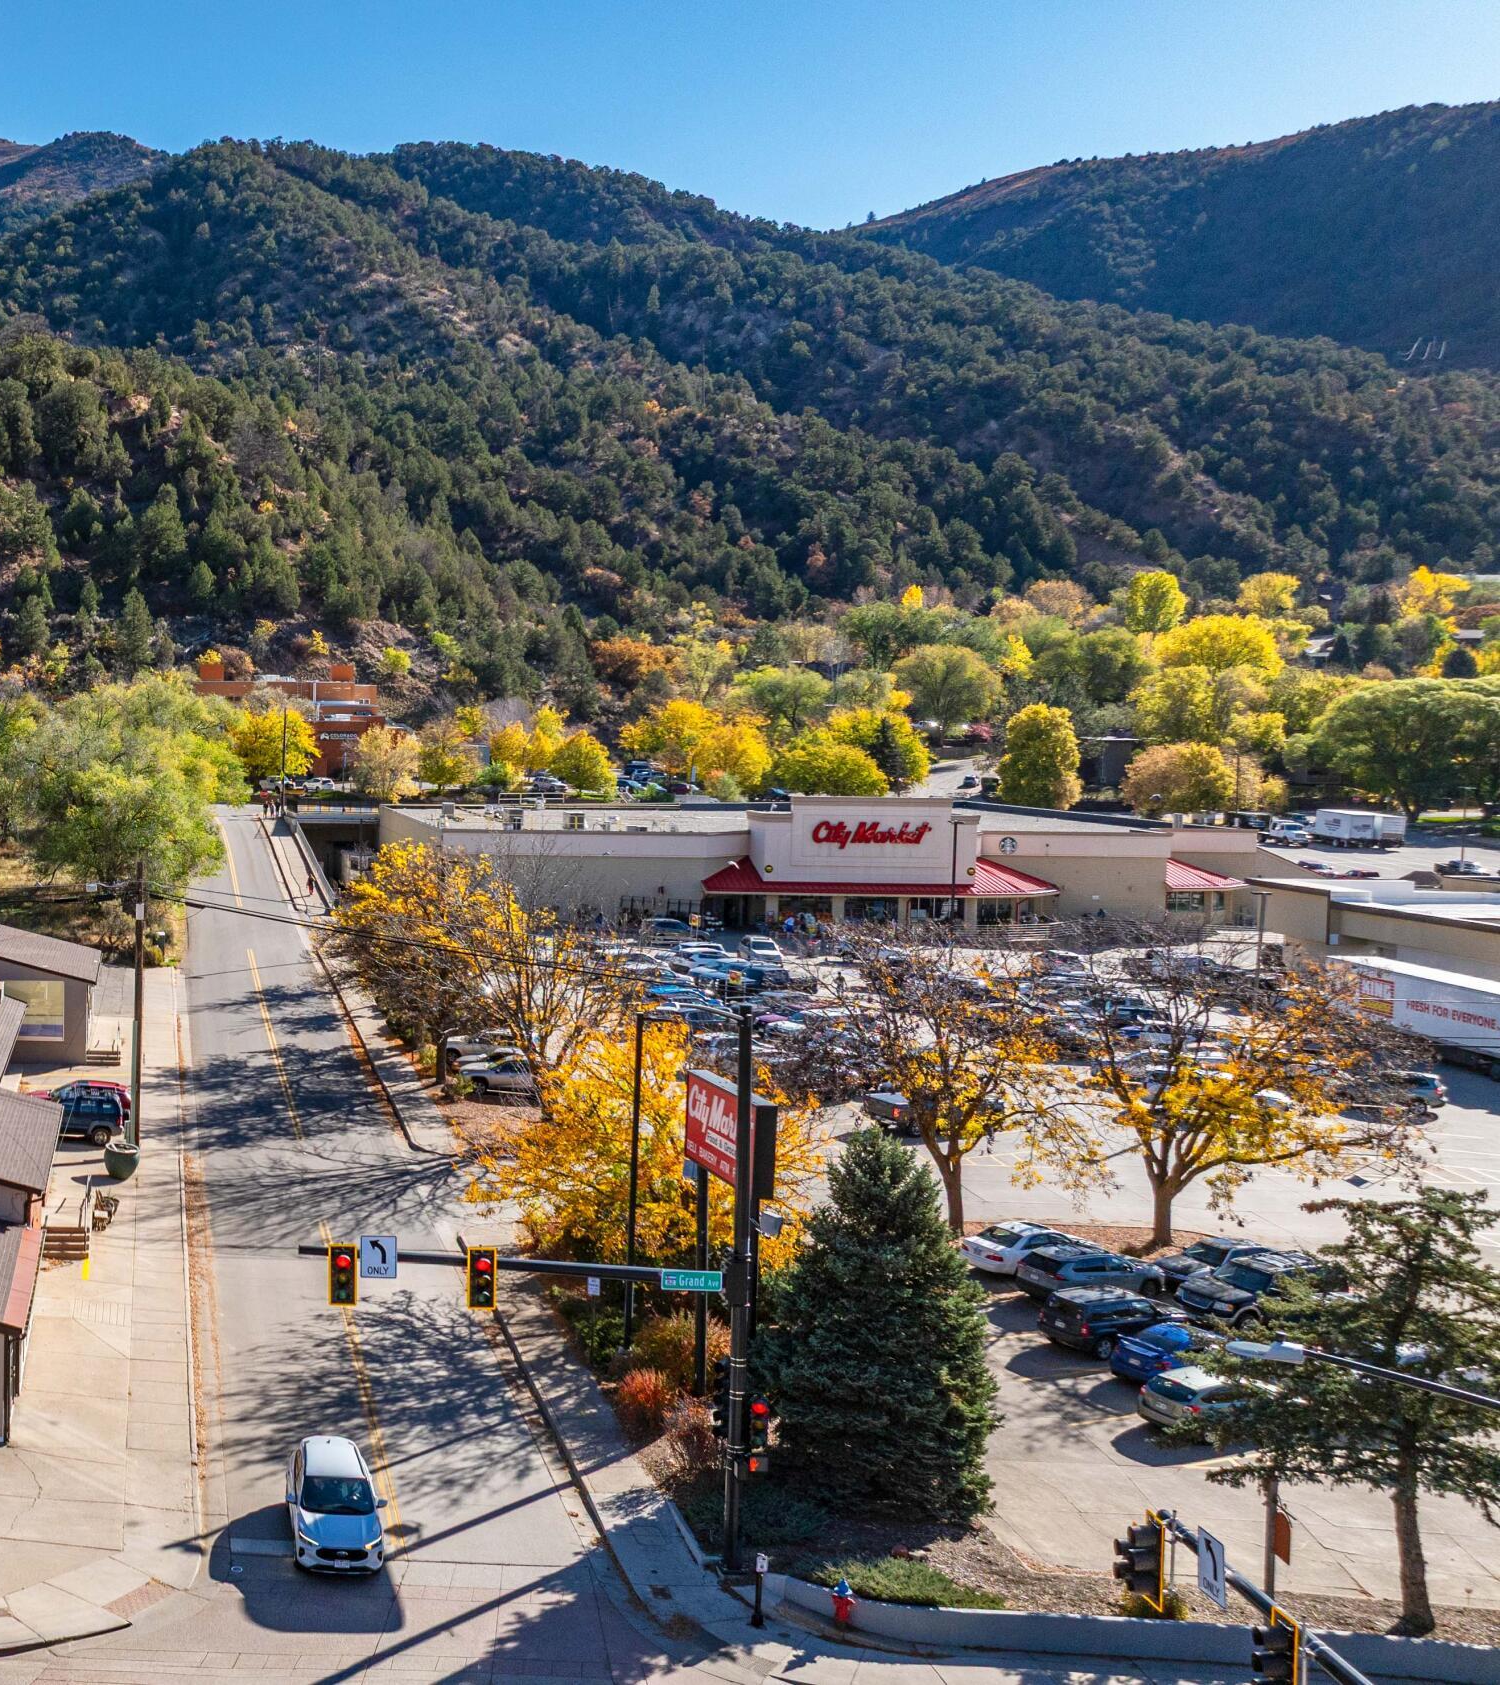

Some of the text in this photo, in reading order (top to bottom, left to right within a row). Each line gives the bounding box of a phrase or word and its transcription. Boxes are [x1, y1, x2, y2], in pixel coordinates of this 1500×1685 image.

[811, 821, 932, 849] City Market
[1406, 1000, 1430, 1013] FRESH
[1432, 1004, 1448, 1018] FOR
[688, 1084, 737, 1140] City Mar
[367, 1266, 389, 1275] ONLY
[679, 1275, 705, 1287] Grand
[708, 1280, 719, 1288] Ave
[1203, 1577, 1220, 1598] ONLY
